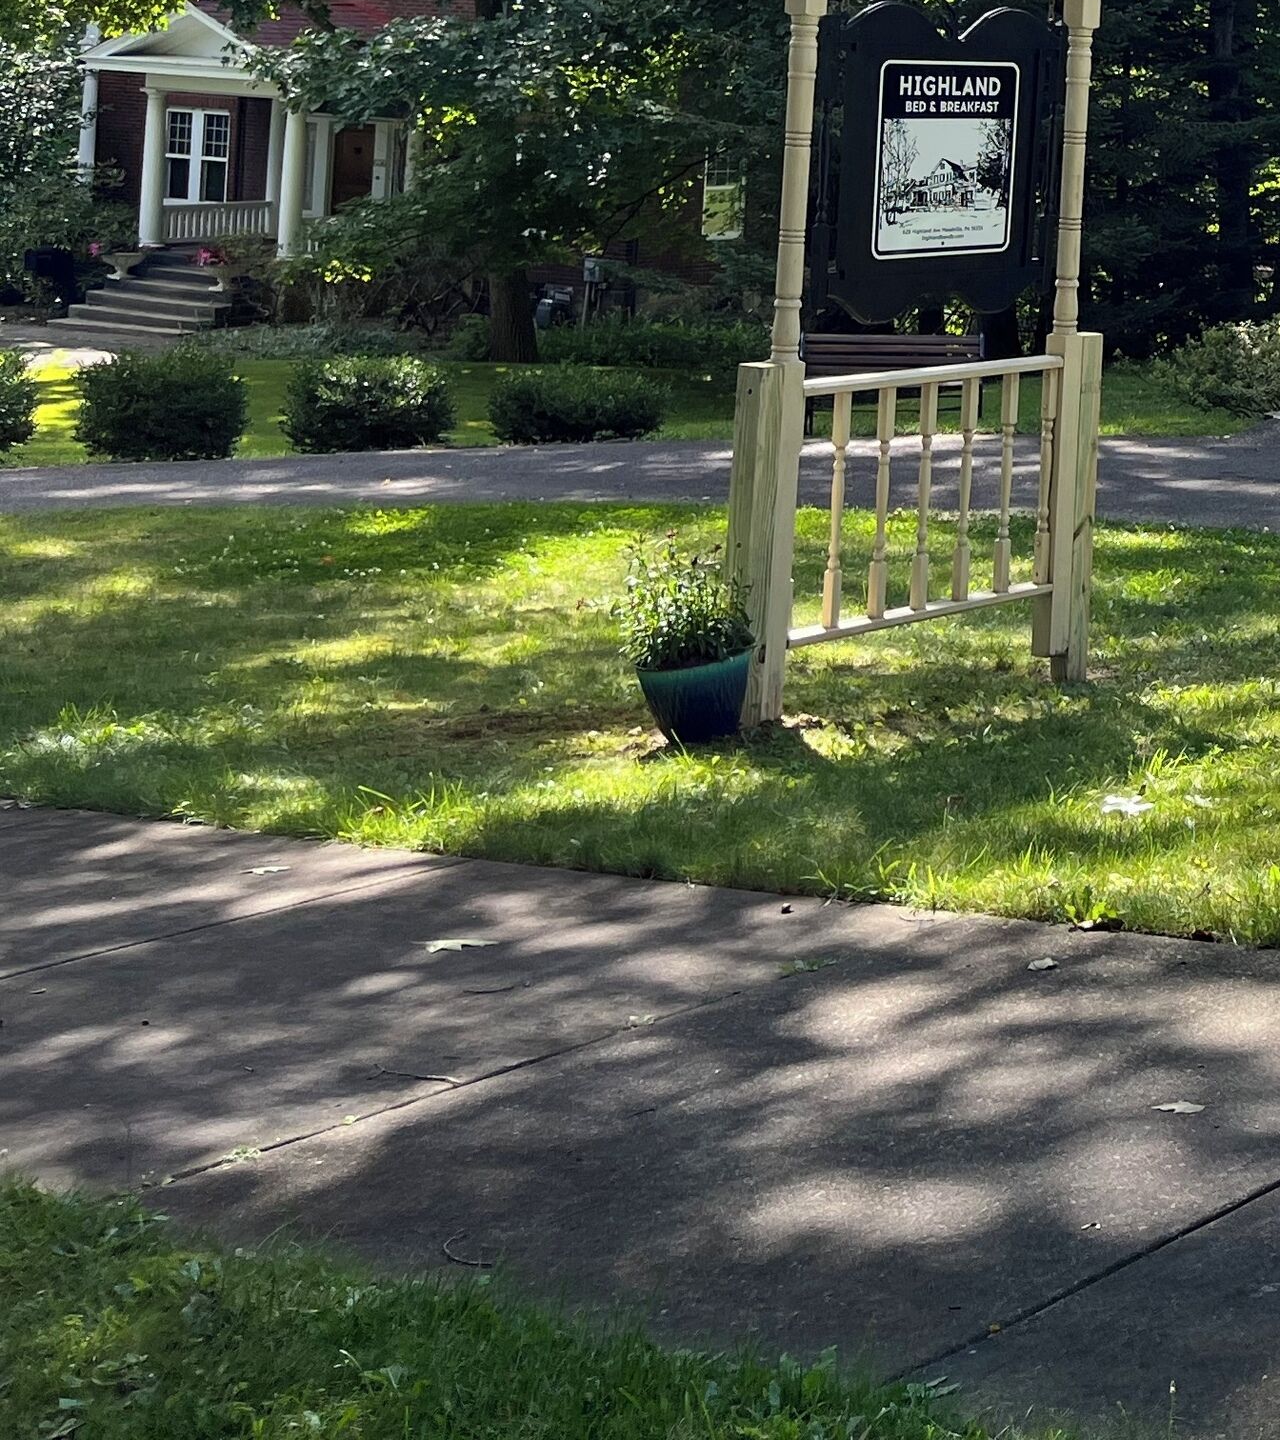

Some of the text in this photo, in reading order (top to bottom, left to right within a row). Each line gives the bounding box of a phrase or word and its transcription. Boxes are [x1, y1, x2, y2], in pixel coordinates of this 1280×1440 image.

[899, 75, 1001, 96] HIGHLAND
[905, 100, 1000, 113] BED & BREAKFAST
